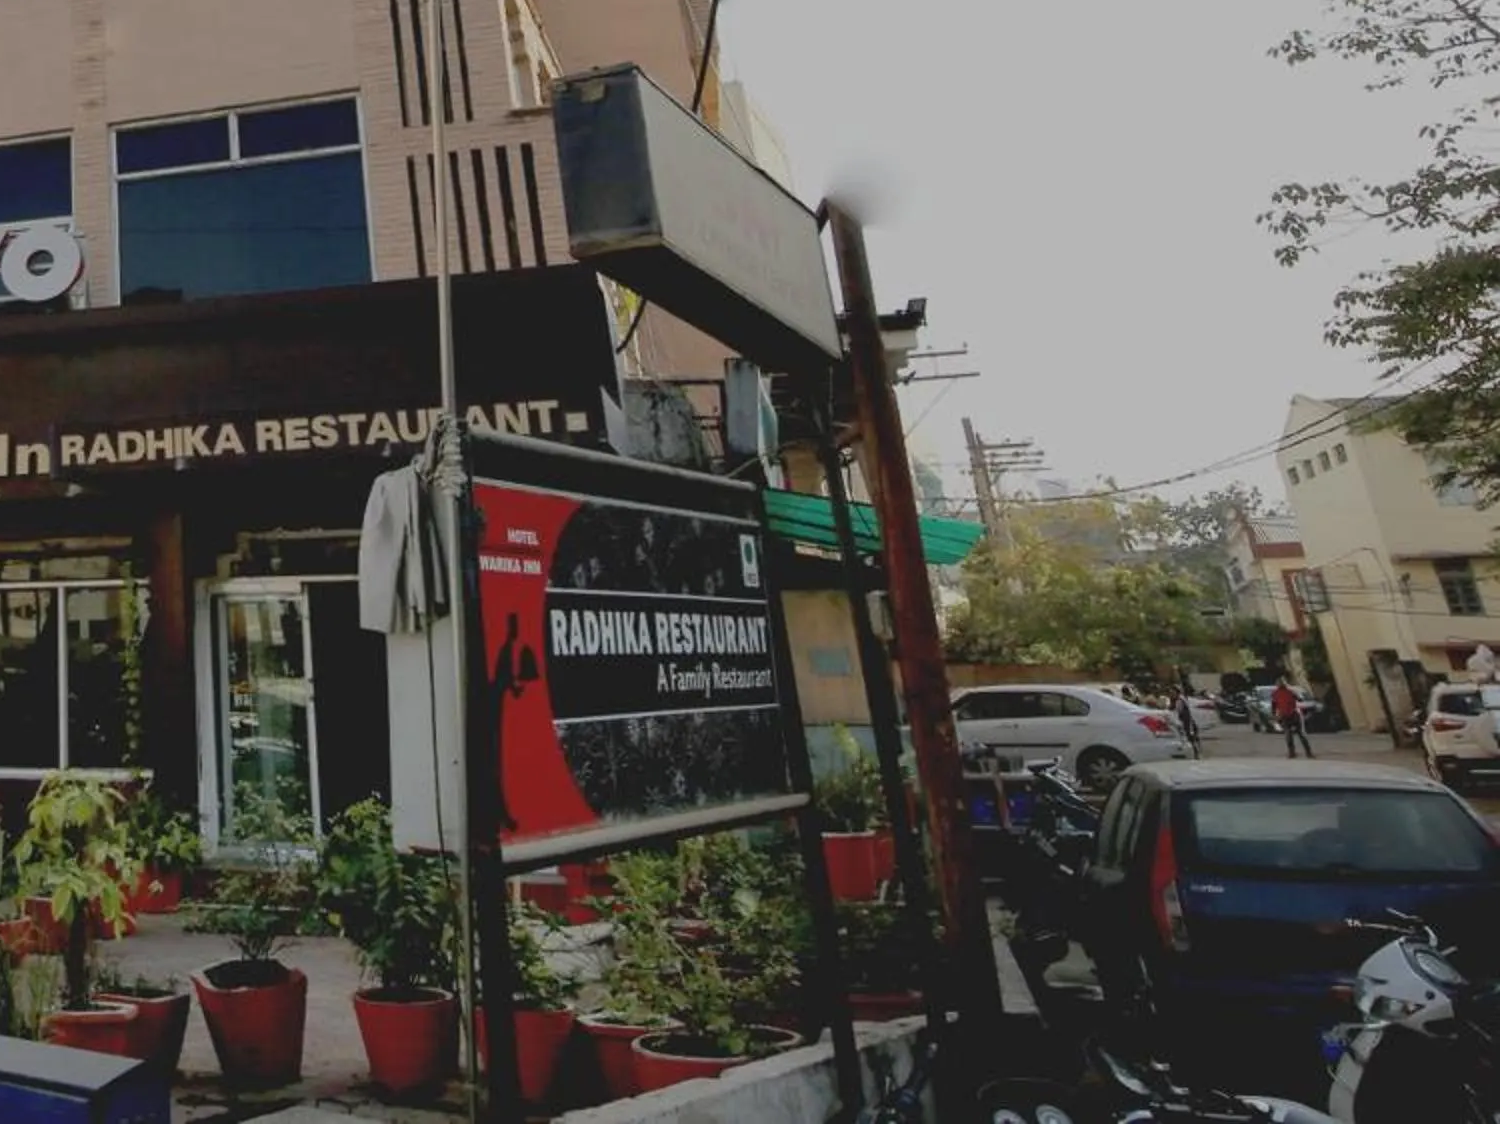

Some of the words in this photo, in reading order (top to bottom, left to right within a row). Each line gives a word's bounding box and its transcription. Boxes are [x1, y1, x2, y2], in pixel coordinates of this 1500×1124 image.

[61, 422, 245, 467] RADHIKA
[507, 527, 539, 545] HOTEL
[479, 555, 521, 573] WARIKA
[550, 609, 652, 656] RADHIKA
[655, 613, 768, 655] RESTAURANT
[657, 662, 669, 693] A
[670, 662, 711, 698] Family
[712, 662, 772, 690] Restaurant
